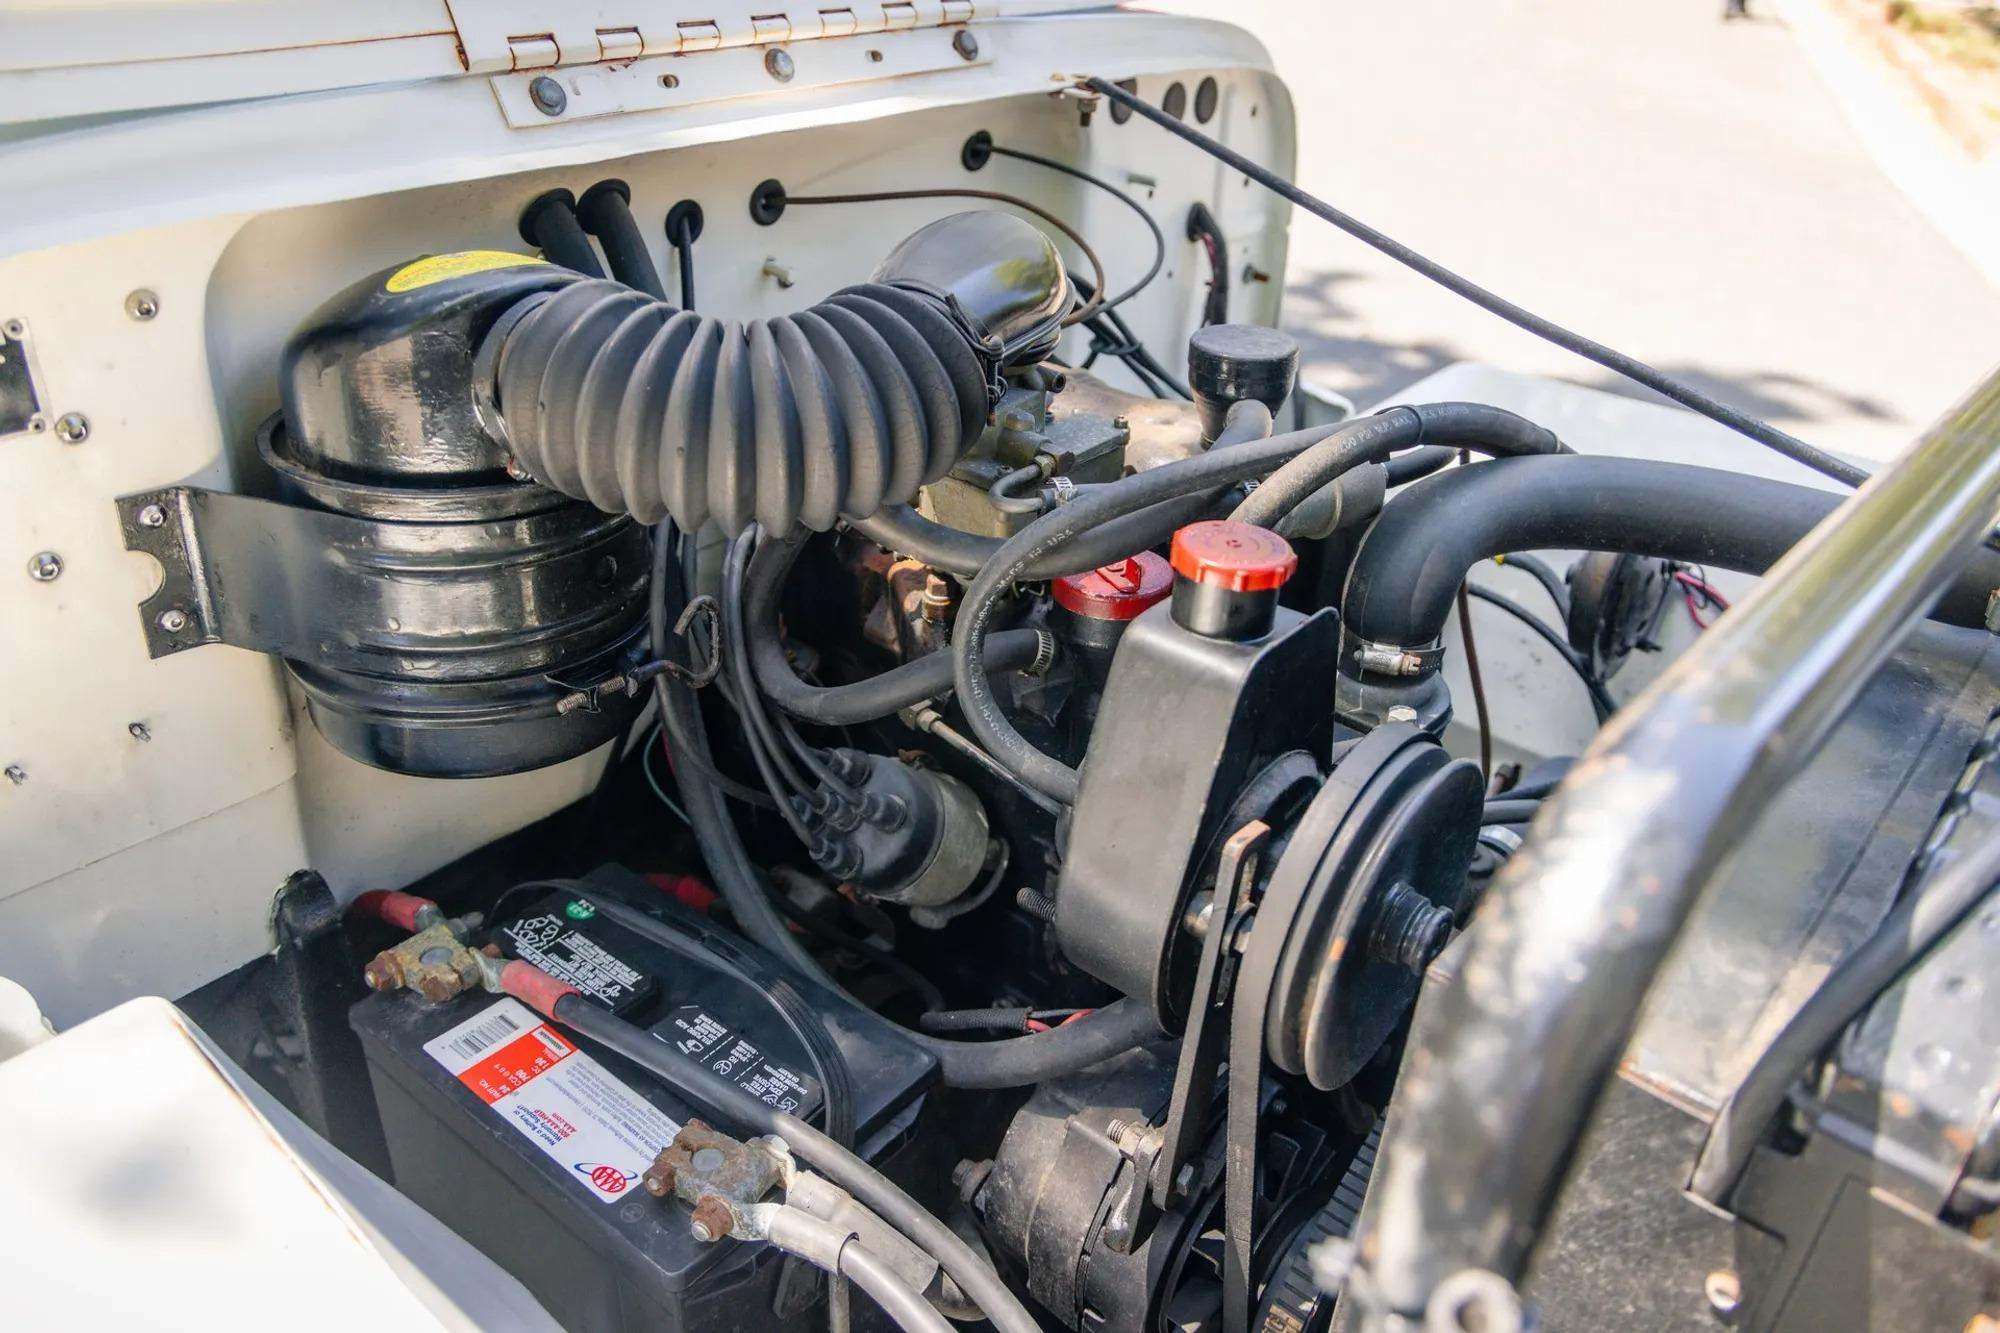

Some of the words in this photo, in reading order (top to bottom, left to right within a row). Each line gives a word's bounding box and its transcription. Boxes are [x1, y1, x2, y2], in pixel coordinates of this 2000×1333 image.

[675, 1018, 689, 1029] ACID
[686, 1028, 712, 1045] SULFURIC
[728, 1055, 739, 1064] NO
[750, 1081, 767, 1092] EYES
[753, 1074, 783, 1095] EXPLOSIVE
[769, 1077, 788, 1091] GASES
[517, 1105, 540, 1123] Support?
[519, 1114, 536, 1131] Battery
[540, 1122, 562, 1141] Warranty
[552, 1113, 577, 1133] AAA.com
[540, 1133, 556, 1146] Need
[592, 1166, 627, 1192] AAA
